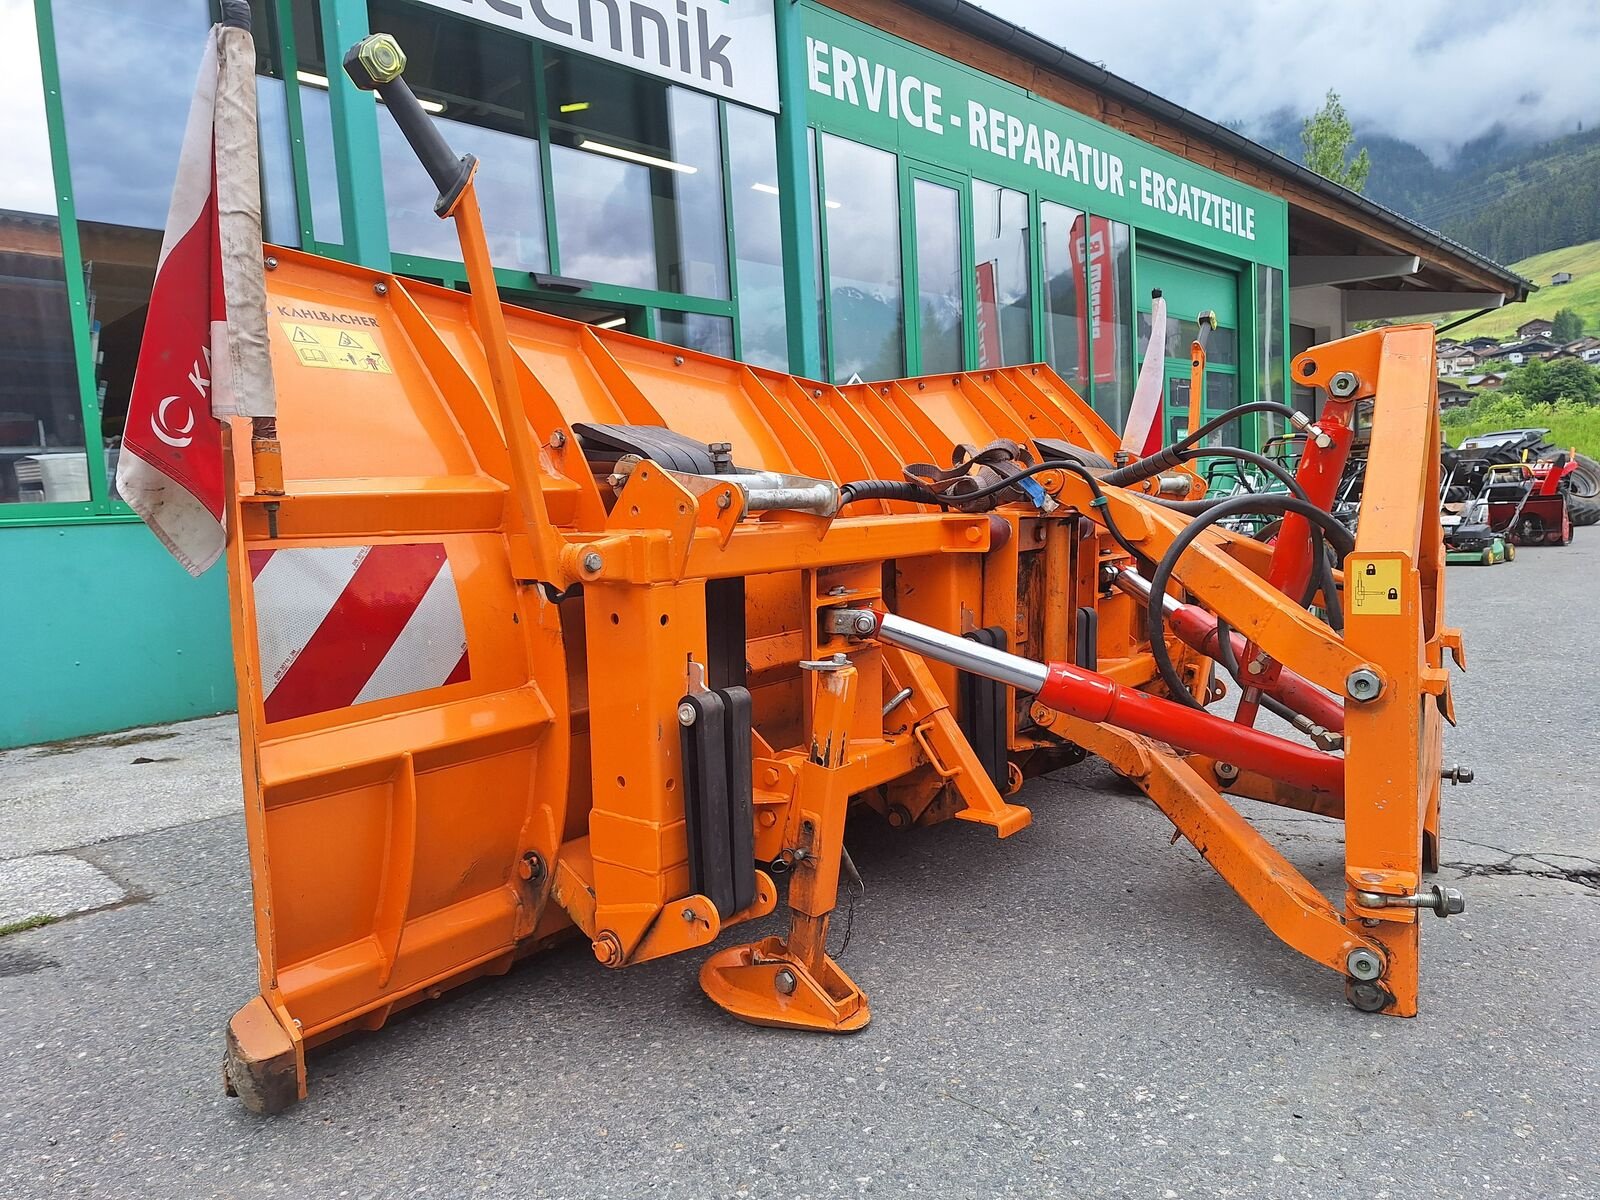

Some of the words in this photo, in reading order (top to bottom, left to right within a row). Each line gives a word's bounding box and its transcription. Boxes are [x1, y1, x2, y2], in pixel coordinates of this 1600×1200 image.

[461, 0, 734, 88] chnik
[806, 36, 944, 135] ERVICE
[968, 99, 1125, 197] REPARATUR
[1140, 166, 1256, 241] ERSATZTEILE
[277, 306, 380, 328] KAHLBACHER
[273, 670, 282, 679] DIN
